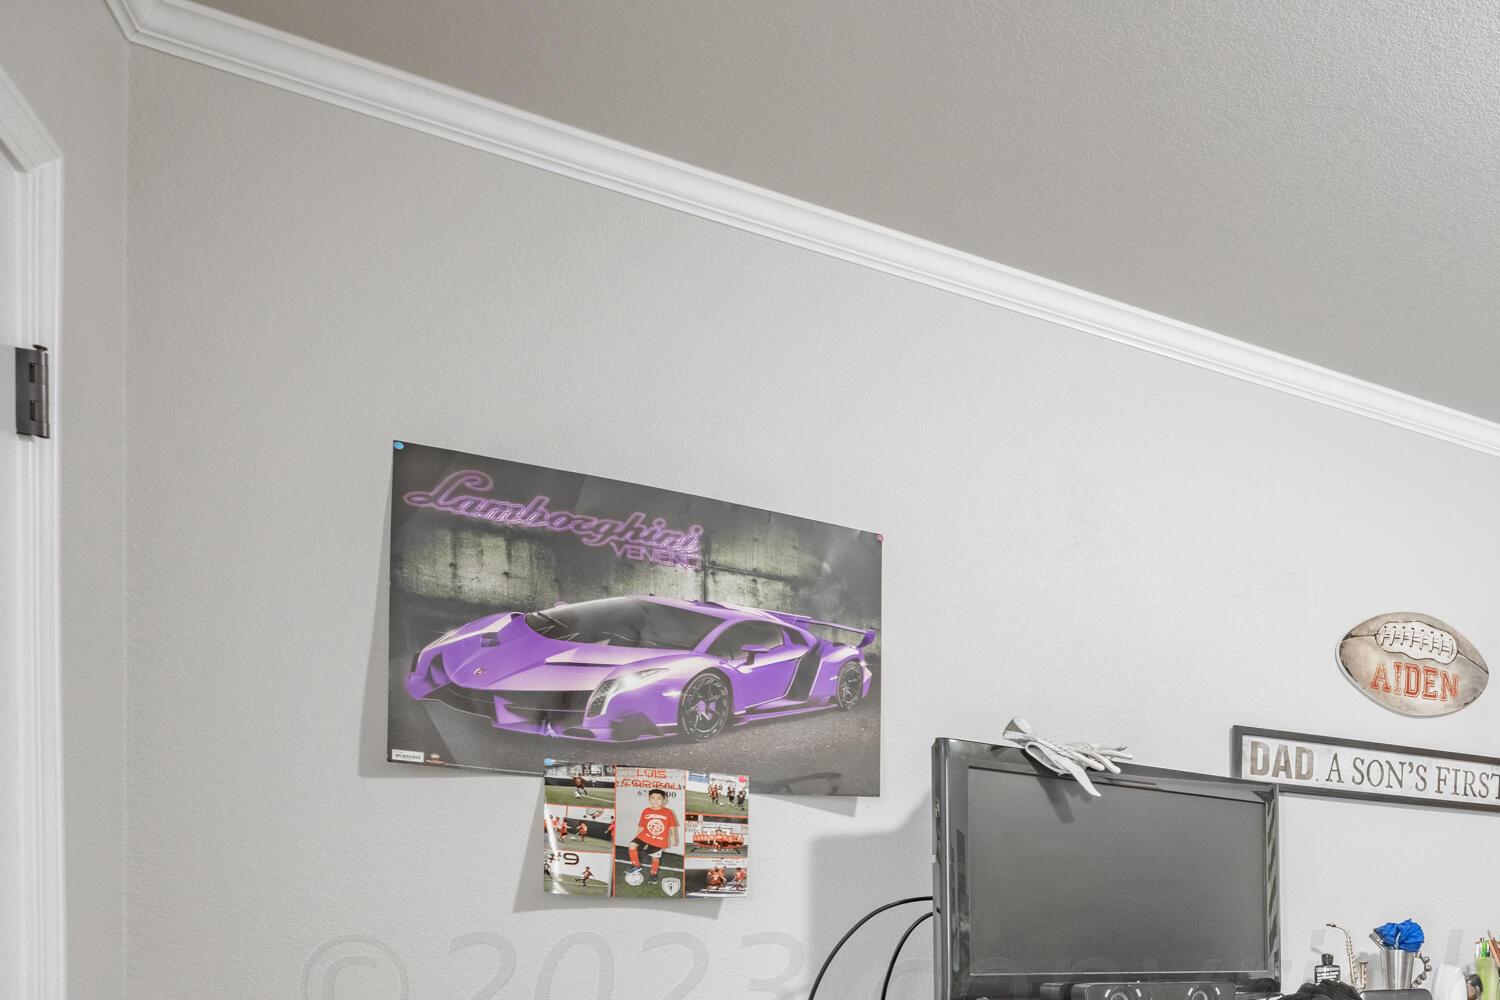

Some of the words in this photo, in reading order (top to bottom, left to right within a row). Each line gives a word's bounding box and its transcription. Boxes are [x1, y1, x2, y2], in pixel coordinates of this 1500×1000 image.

[403, 469, 703, 550] Lamborghini
[1370, 661, 1459, 702] AIDEN
[1325, 752, 1344, 784] A
[1351, 757, 1428, 792] SON'S
